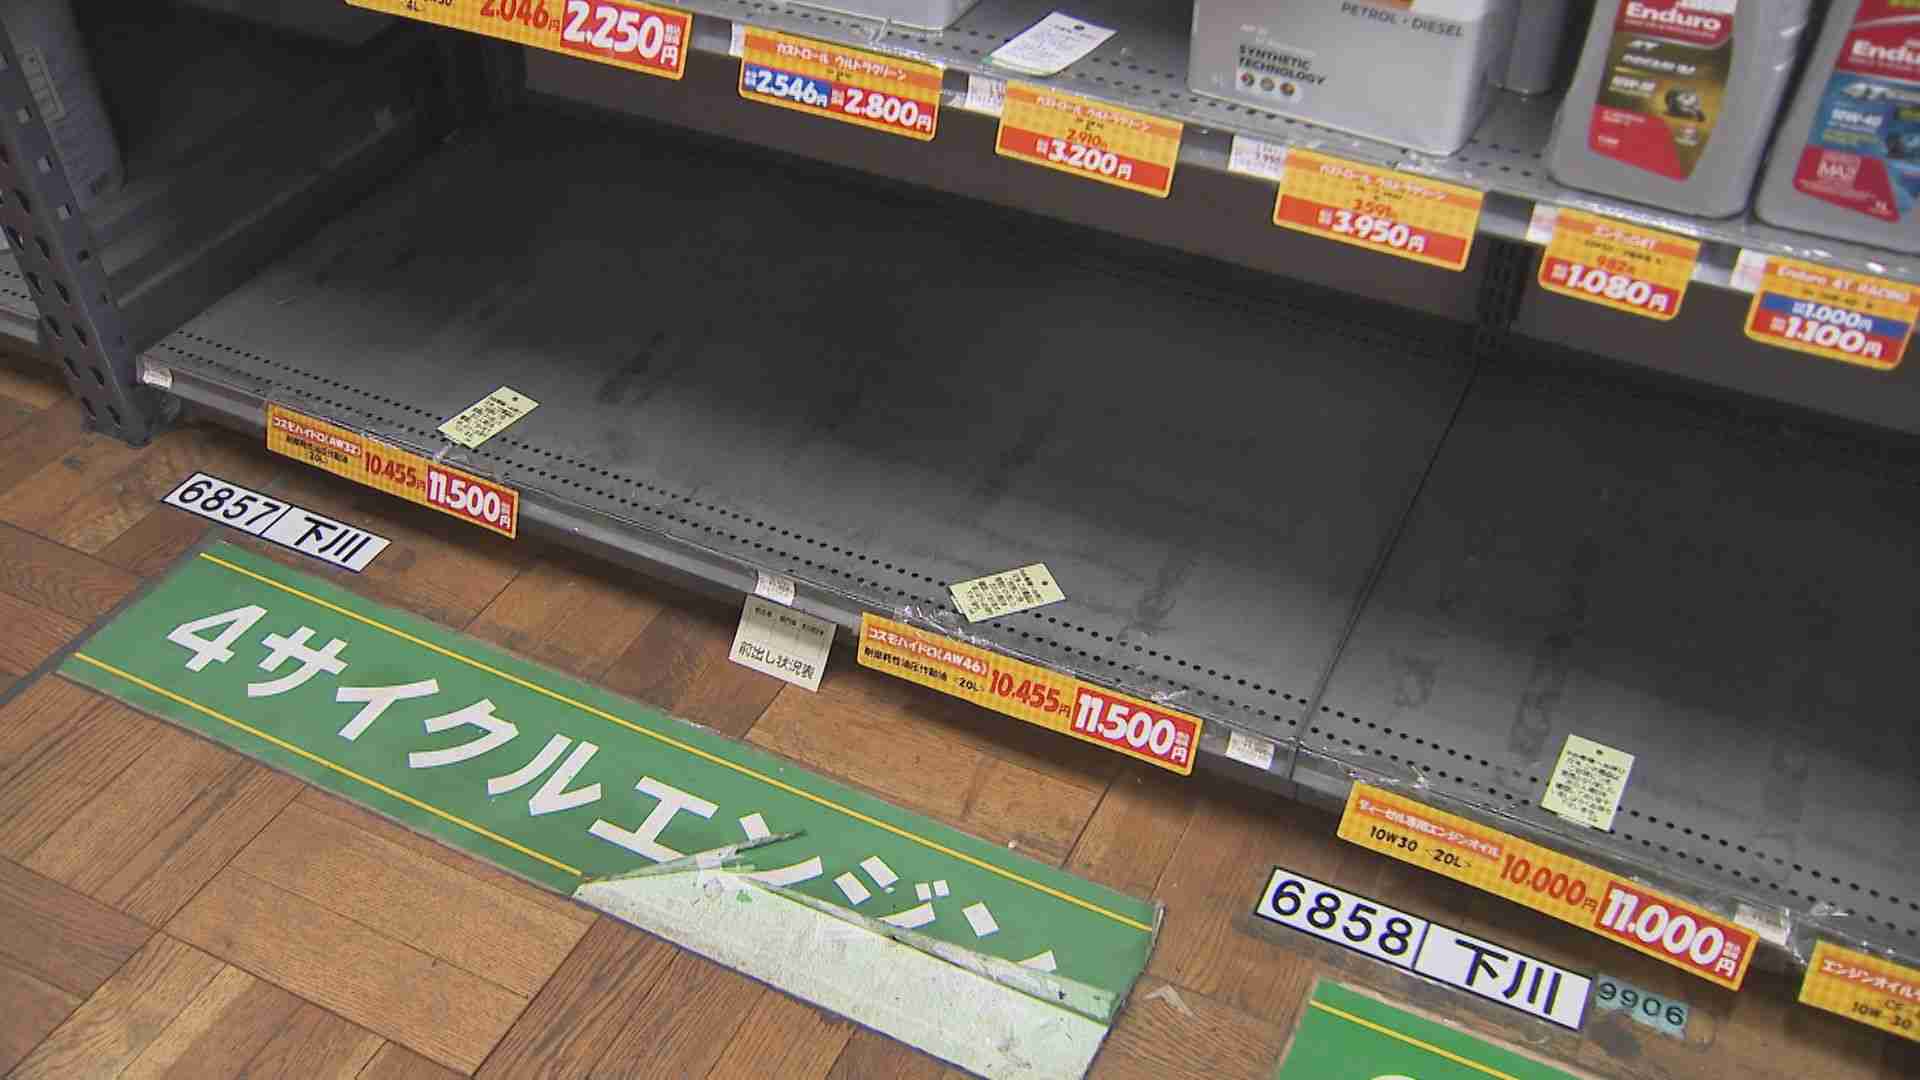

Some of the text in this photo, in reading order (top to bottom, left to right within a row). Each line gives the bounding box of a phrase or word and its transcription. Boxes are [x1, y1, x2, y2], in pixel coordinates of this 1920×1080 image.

[1341, 0, 1464, 38] PETROL DIESEL
[1625, 1, 1721, 31] Enduro
[1239, 44, 1311, 71] SYNTHETIC
[1239, 56, 1328, 86] TECHNOLOGY
[178, 480, 281, 526] 6857
[294, 515, 372, 564] 下川
[1369, 825, 1419, 853] 10W30
[1271, 879, 1413, 956] 6858
[1455, 938, 1562, 1016] 下川
[1598, 981, 1685, 1027] 9906
